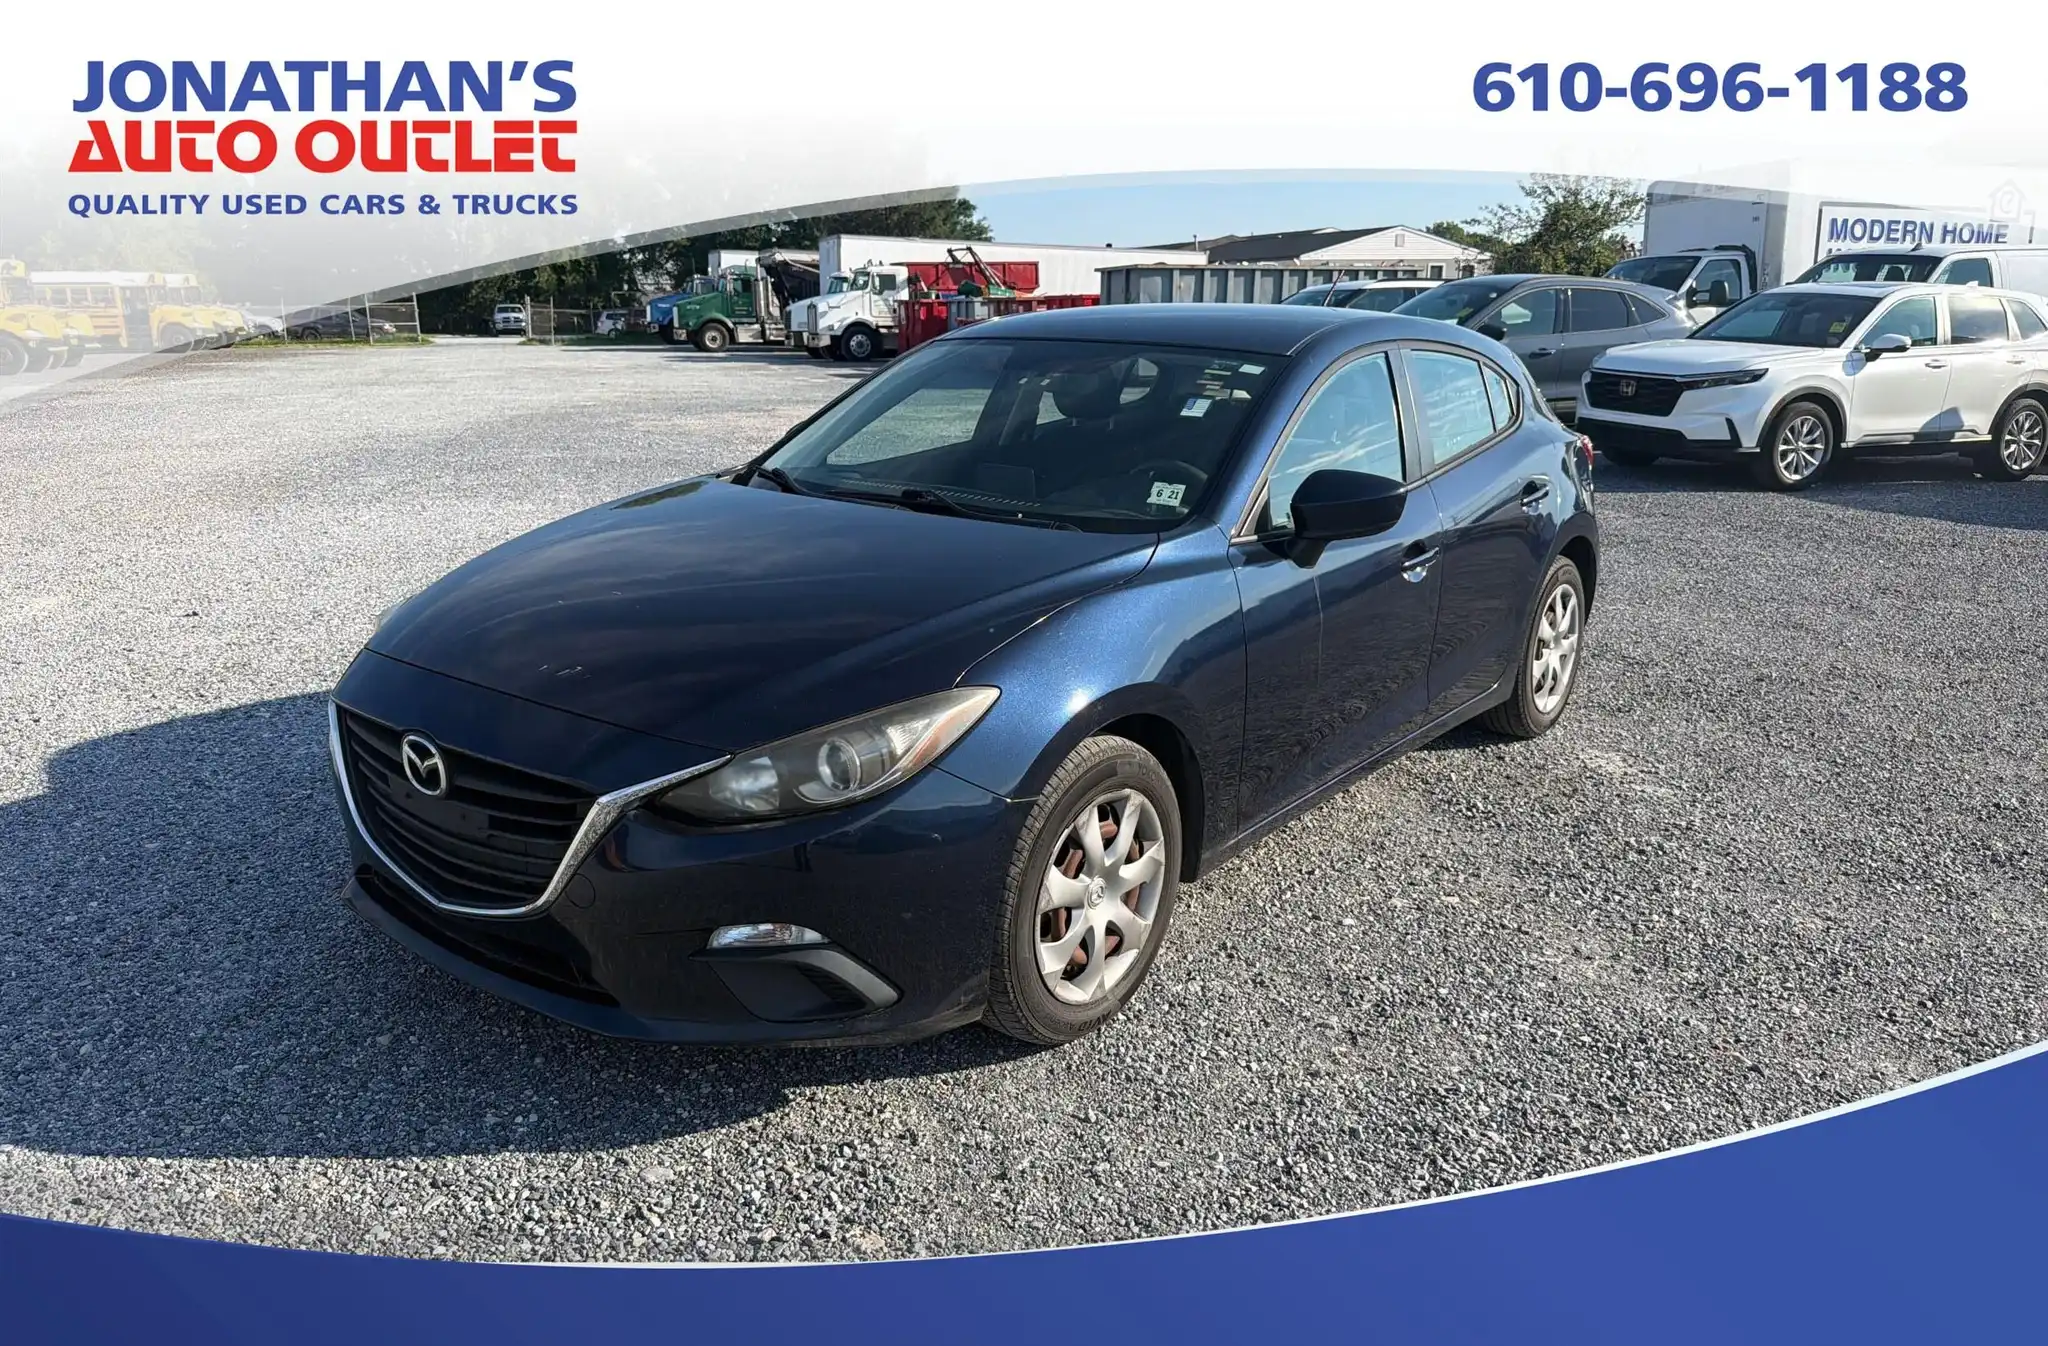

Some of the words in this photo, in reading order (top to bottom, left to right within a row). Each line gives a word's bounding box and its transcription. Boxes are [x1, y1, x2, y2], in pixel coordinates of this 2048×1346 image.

[1828, 218, 1935, 244] MODERN
[1940, 222, 2010, 244] HOME
[1156, 489, 1164, 498] 6
